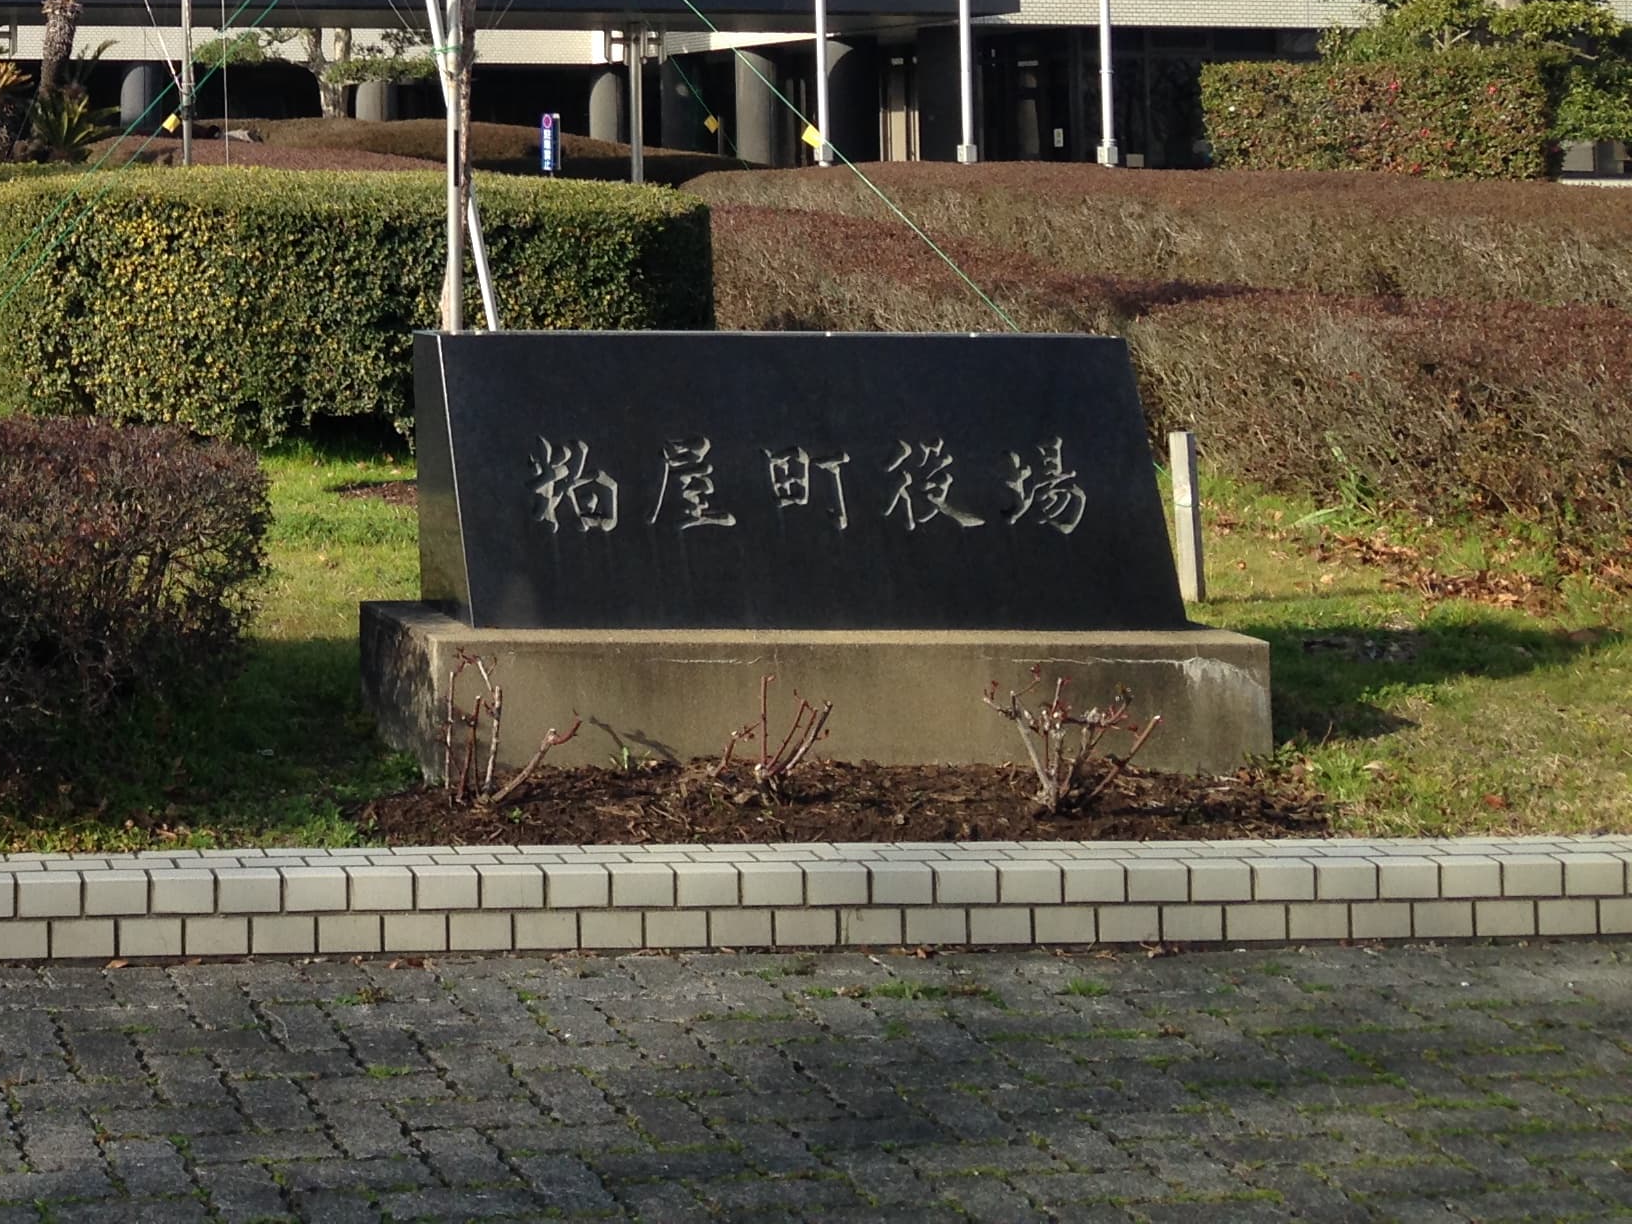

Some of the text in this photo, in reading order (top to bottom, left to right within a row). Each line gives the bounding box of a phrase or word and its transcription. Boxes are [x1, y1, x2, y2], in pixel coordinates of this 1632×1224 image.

[526, 435, 1087, 534] 粕屋町役場
